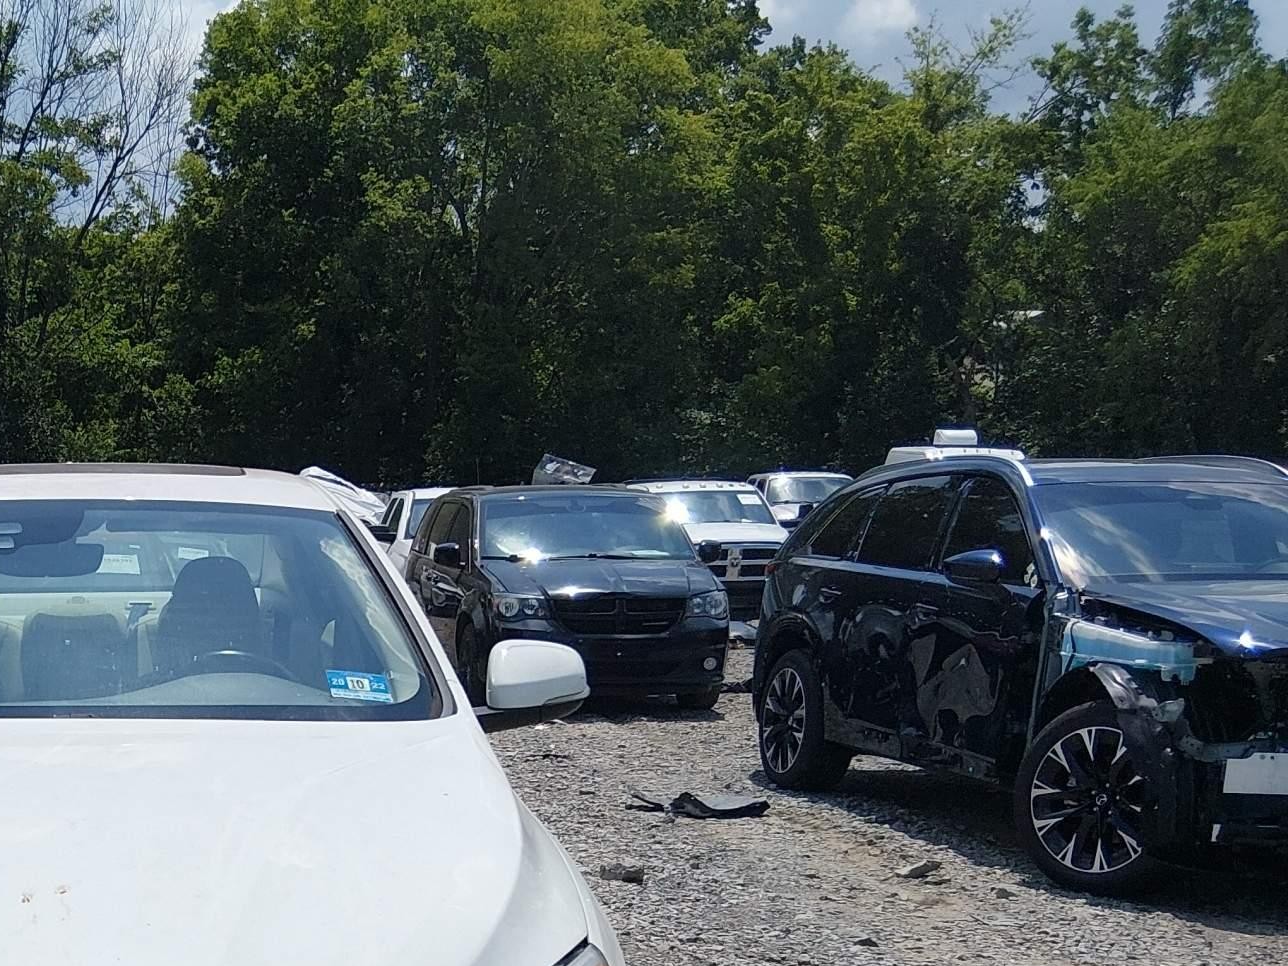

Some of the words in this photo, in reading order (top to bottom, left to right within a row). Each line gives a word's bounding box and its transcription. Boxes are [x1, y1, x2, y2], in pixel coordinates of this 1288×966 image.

[332, 678, 345, 686] 20
[350, 679, 364, 689] 10
[371, 682, 385, 690] 22
